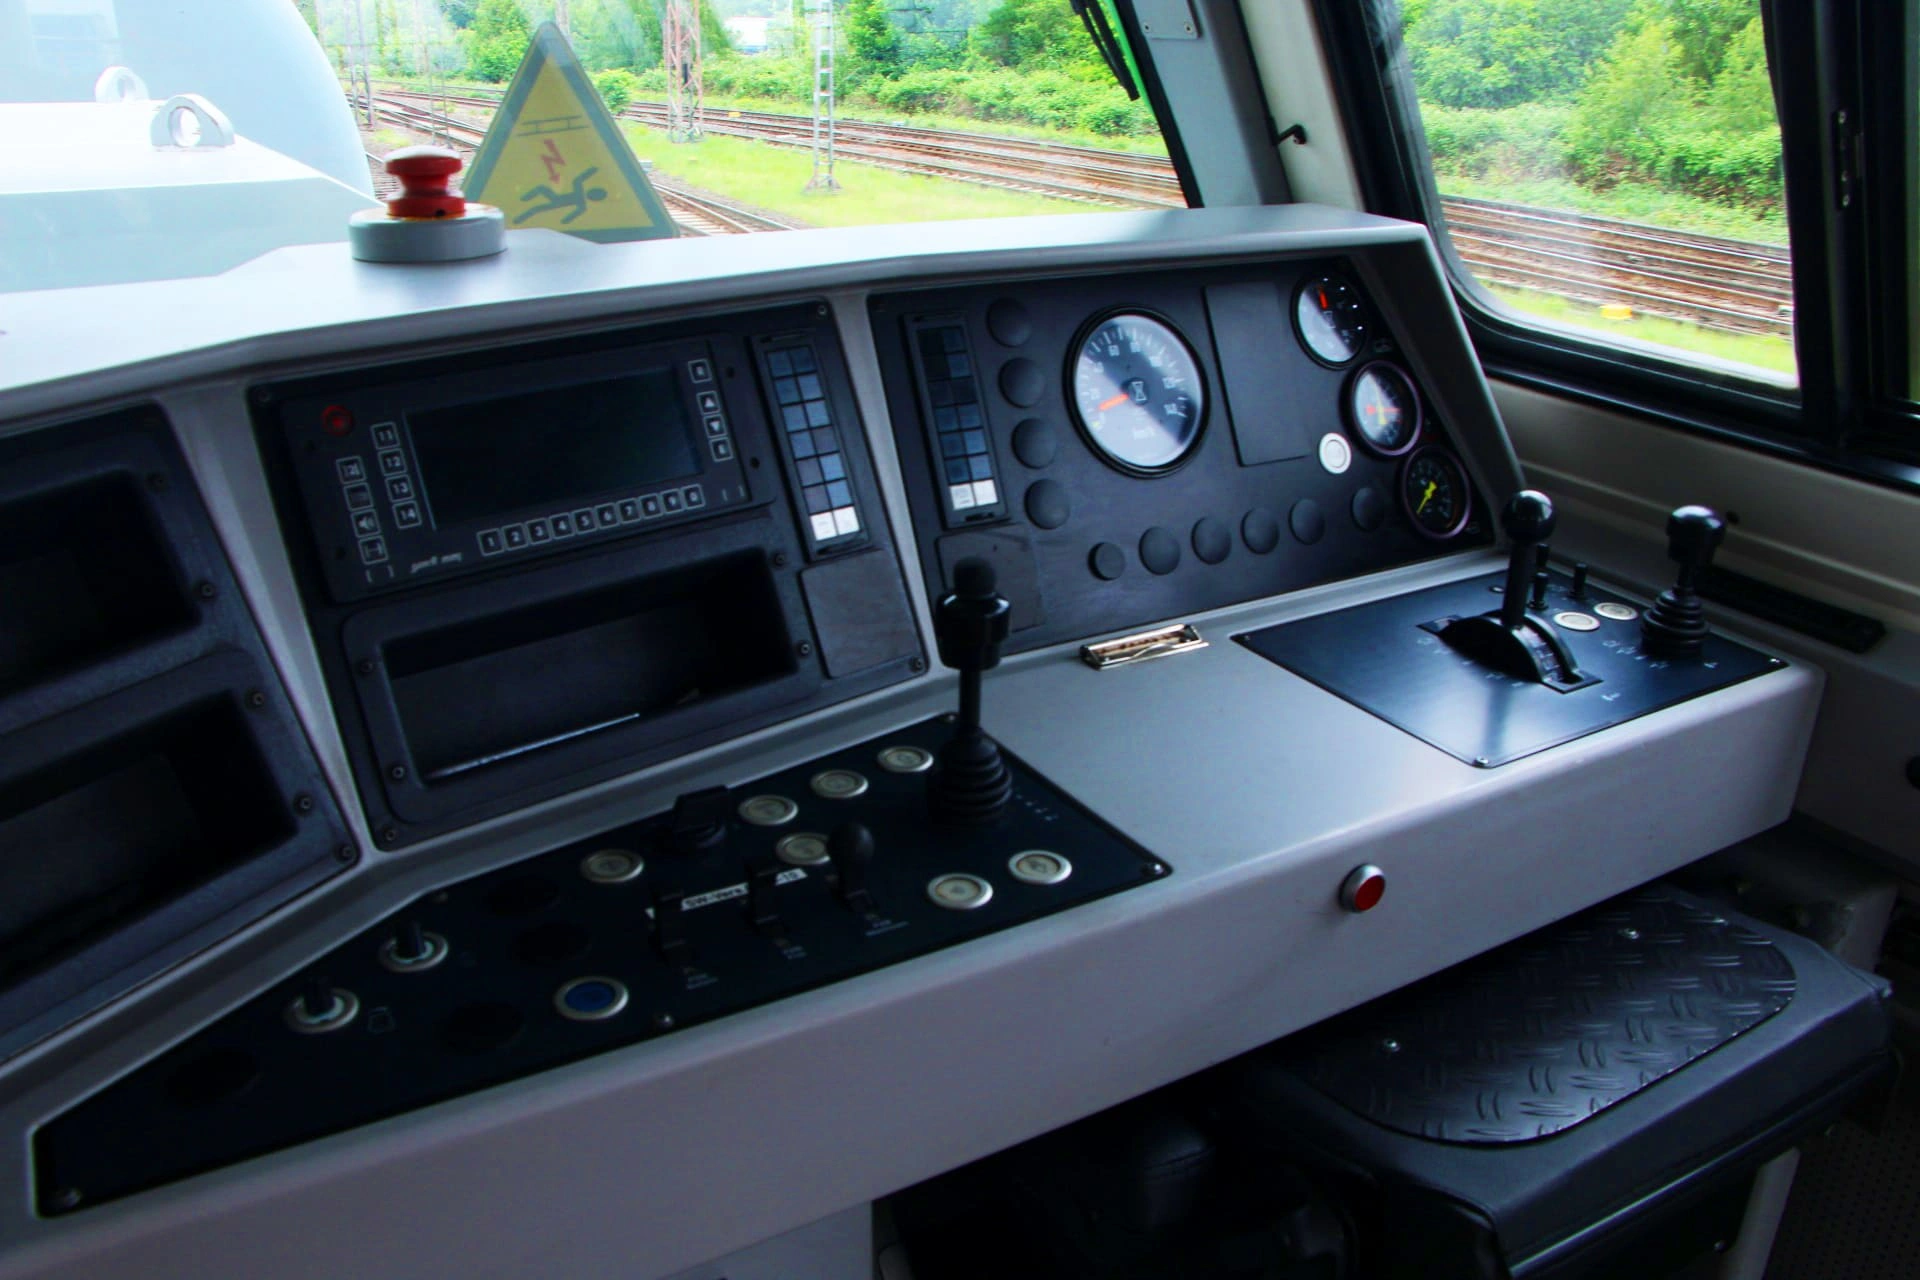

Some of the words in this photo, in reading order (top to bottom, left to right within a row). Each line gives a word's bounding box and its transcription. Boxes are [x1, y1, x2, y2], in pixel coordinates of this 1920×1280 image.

[1108, 344, 1119, 357] 60
[376, 428, 394, 442] 11
[384, 455, 401, 468] 12
[392, 481, 409, 495] 13
[400, 507, 416, 521] 14
